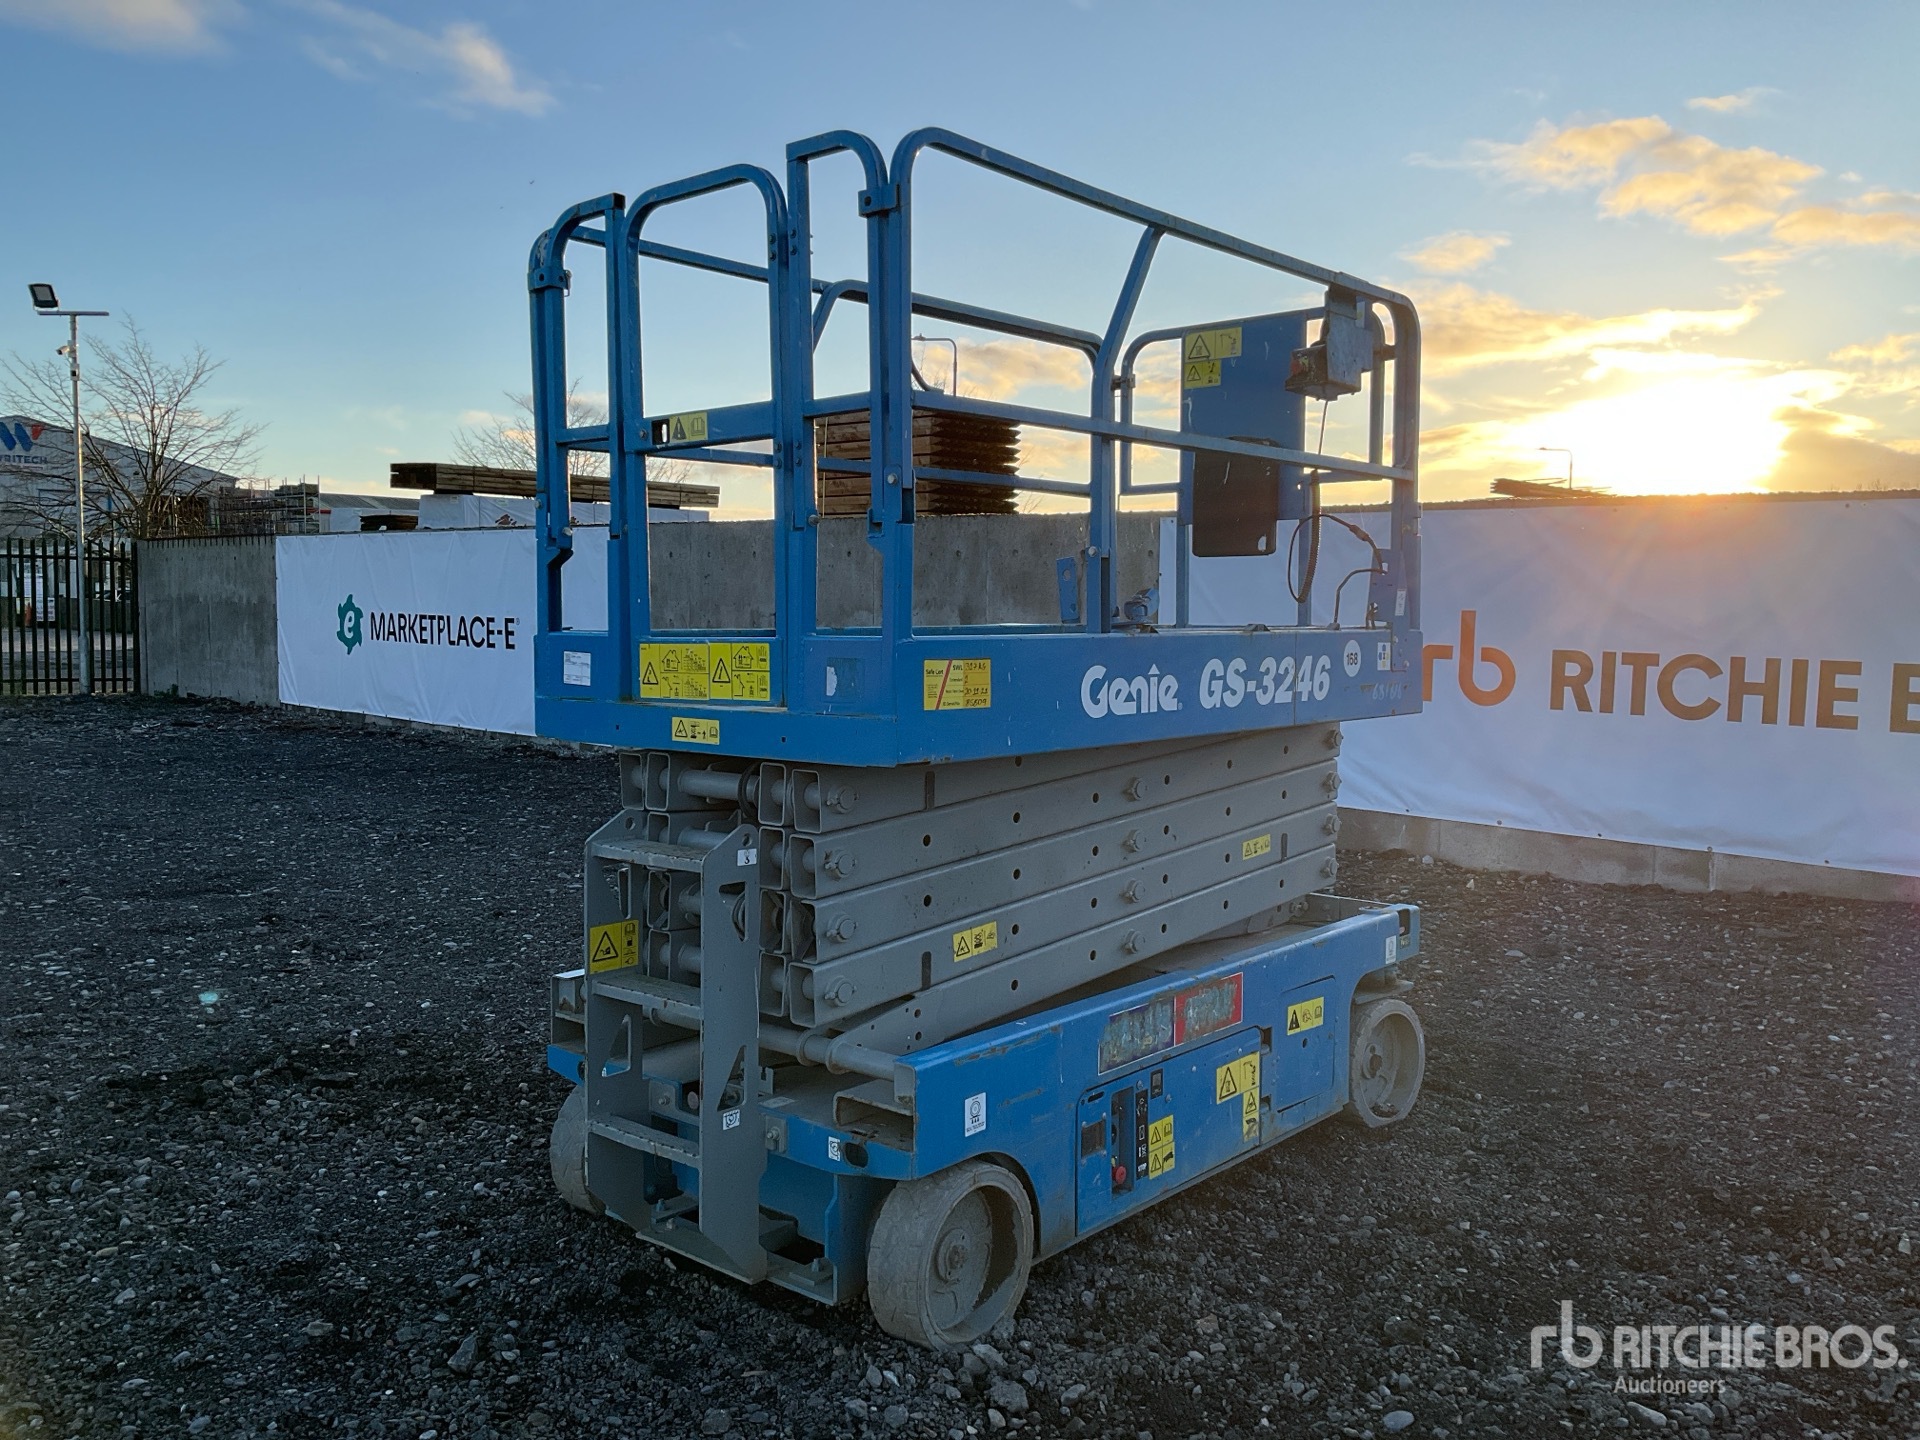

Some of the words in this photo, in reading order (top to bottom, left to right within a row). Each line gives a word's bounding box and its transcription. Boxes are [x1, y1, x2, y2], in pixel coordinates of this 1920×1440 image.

[0, 455, 48, 464] RITECH
[370, 611, 516, 650] MARKETPLACE-E
[1346, 652, 1358, 666] 168
[1080, 663, 1179, 719] Genie
[1199, 654, 1331, 710] GS-3246
[1549, 648, 1863, 730] RITCHIE
